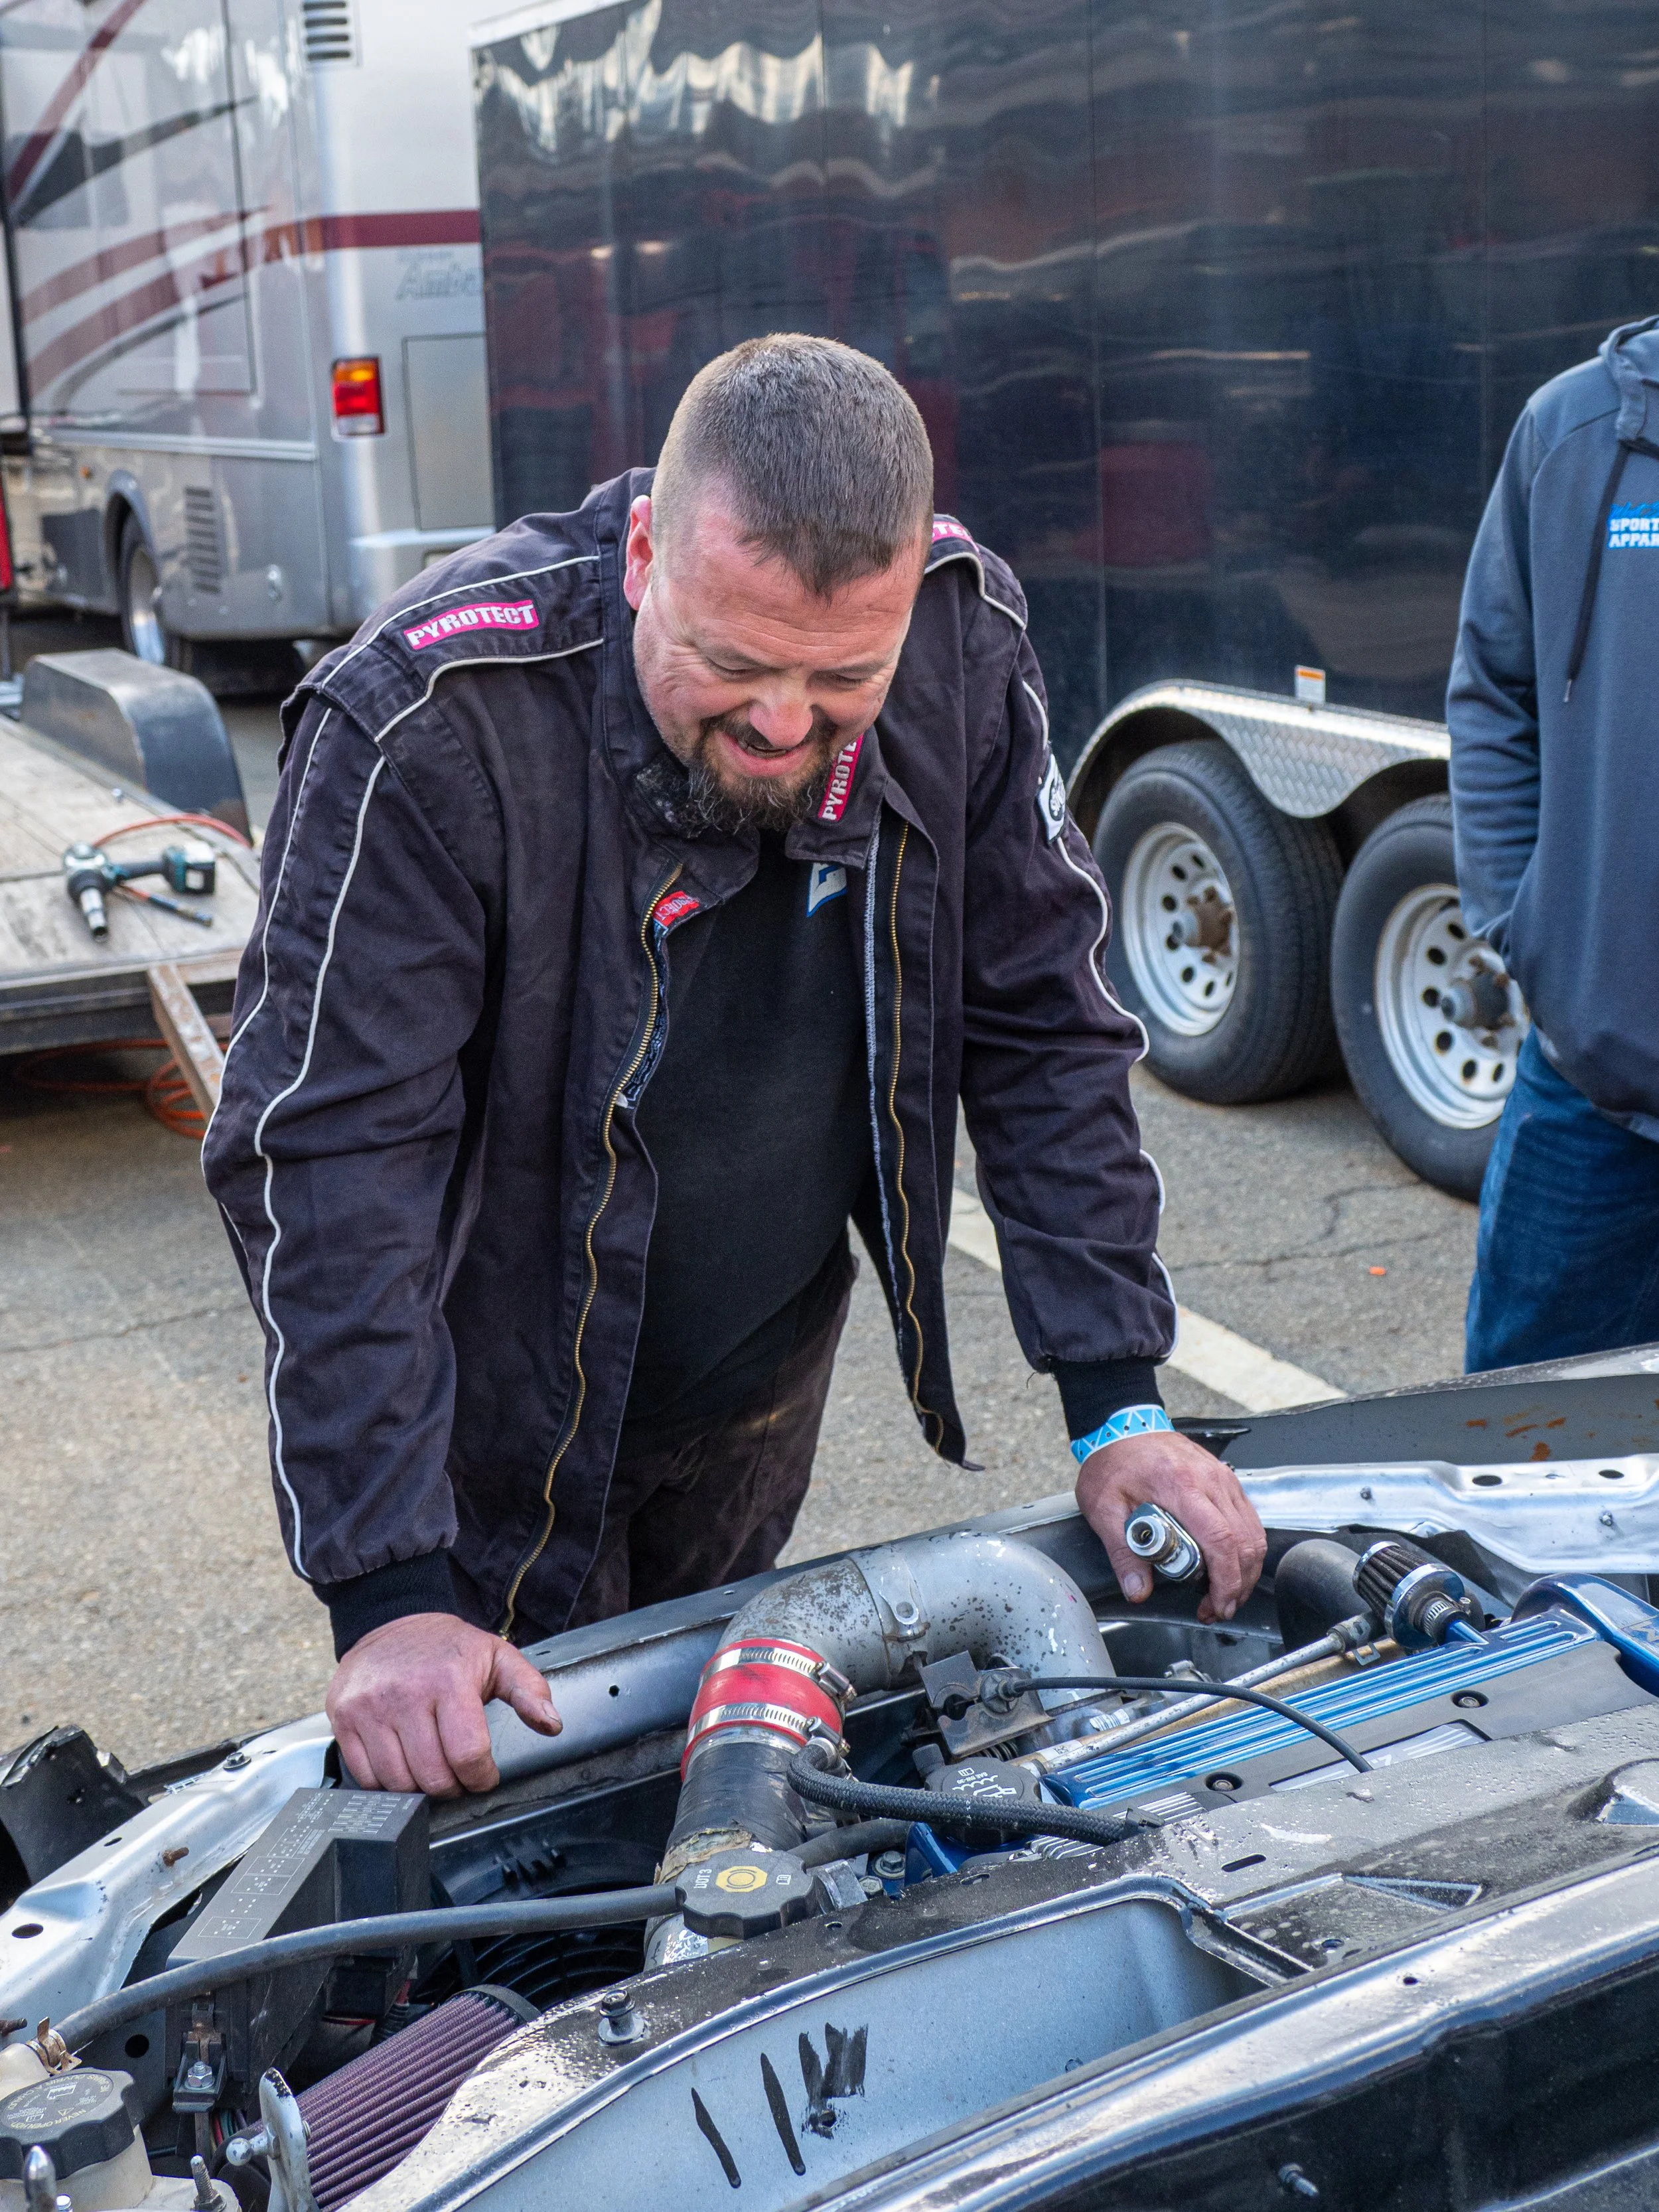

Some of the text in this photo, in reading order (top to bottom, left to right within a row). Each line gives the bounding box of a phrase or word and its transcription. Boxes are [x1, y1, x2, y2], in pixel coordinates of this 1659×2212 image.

[406, 603, 534, 646] PYROTECT
[54, 2108, 87, 2124] NEVER
[29, 2120, 54, 2129] OPEN
